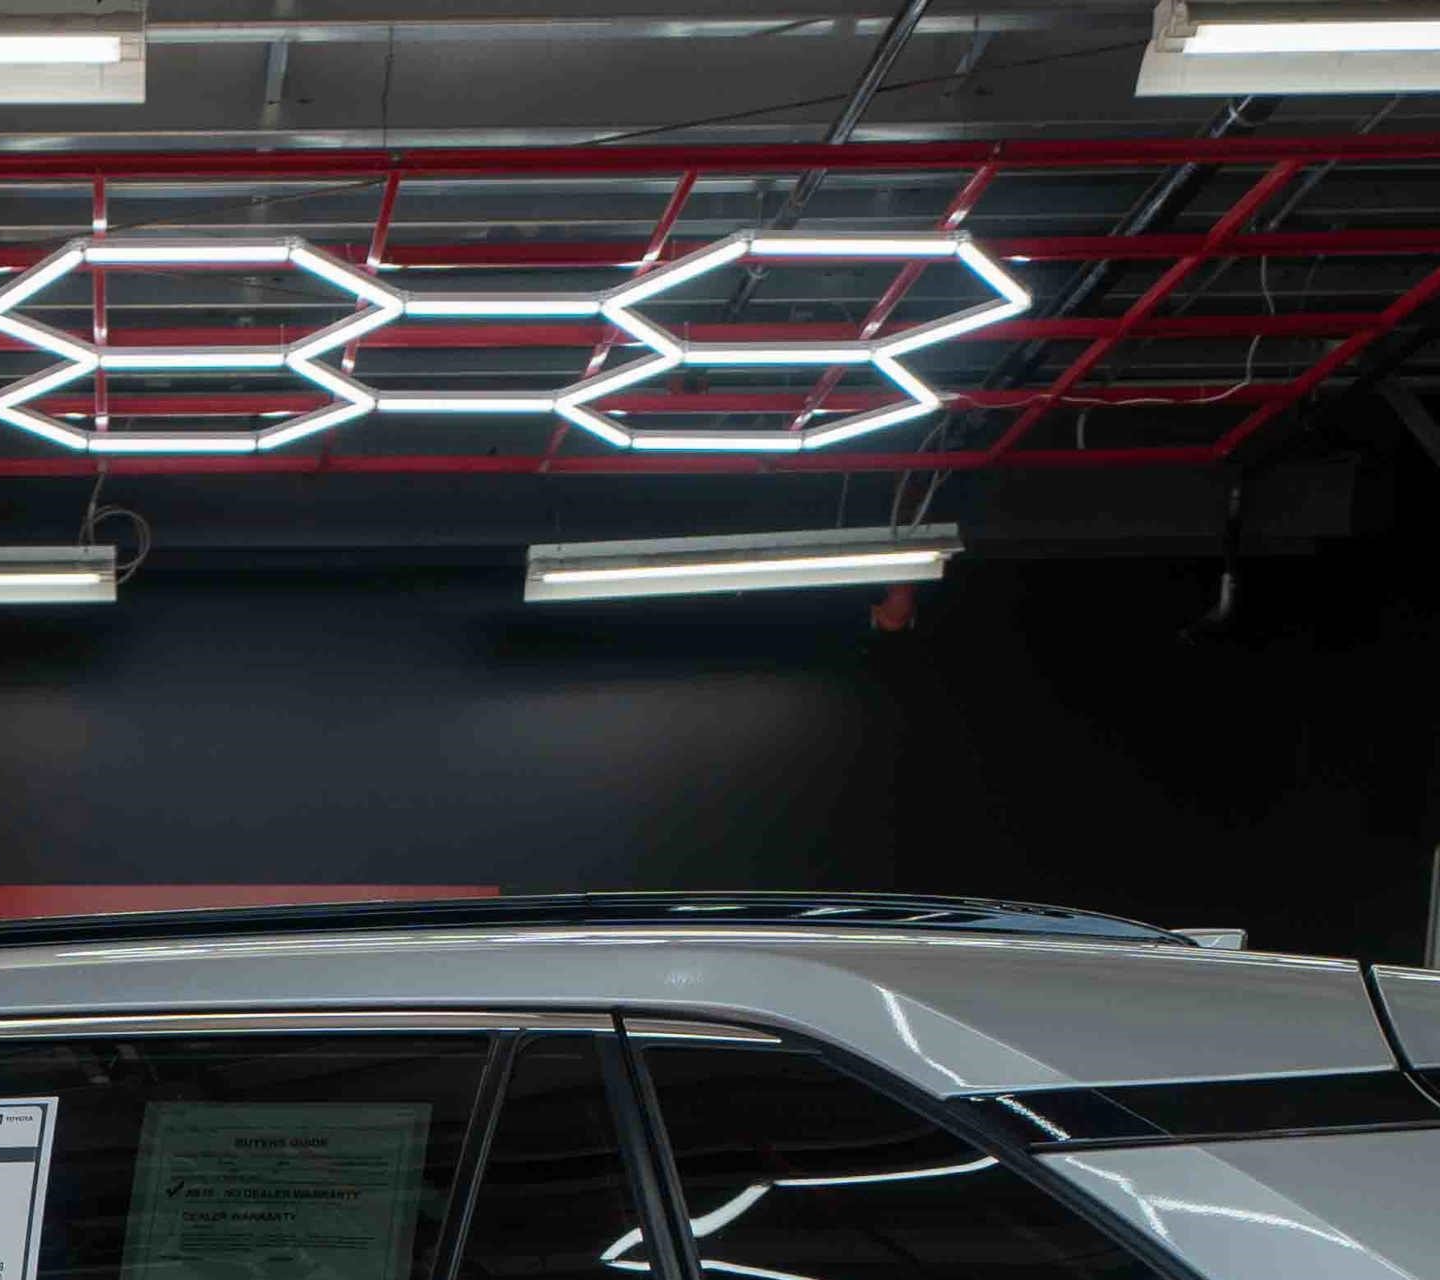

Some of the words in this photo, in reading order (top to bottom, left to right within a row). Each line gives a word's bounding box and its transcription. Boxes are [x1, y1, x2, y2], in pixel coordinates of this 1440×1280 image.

[242, 1188, 292, 1200] DEALER
[293, 1189, 360, 1201] WARRANTY
[230, 1211, 297, 1223] WARRANTY
